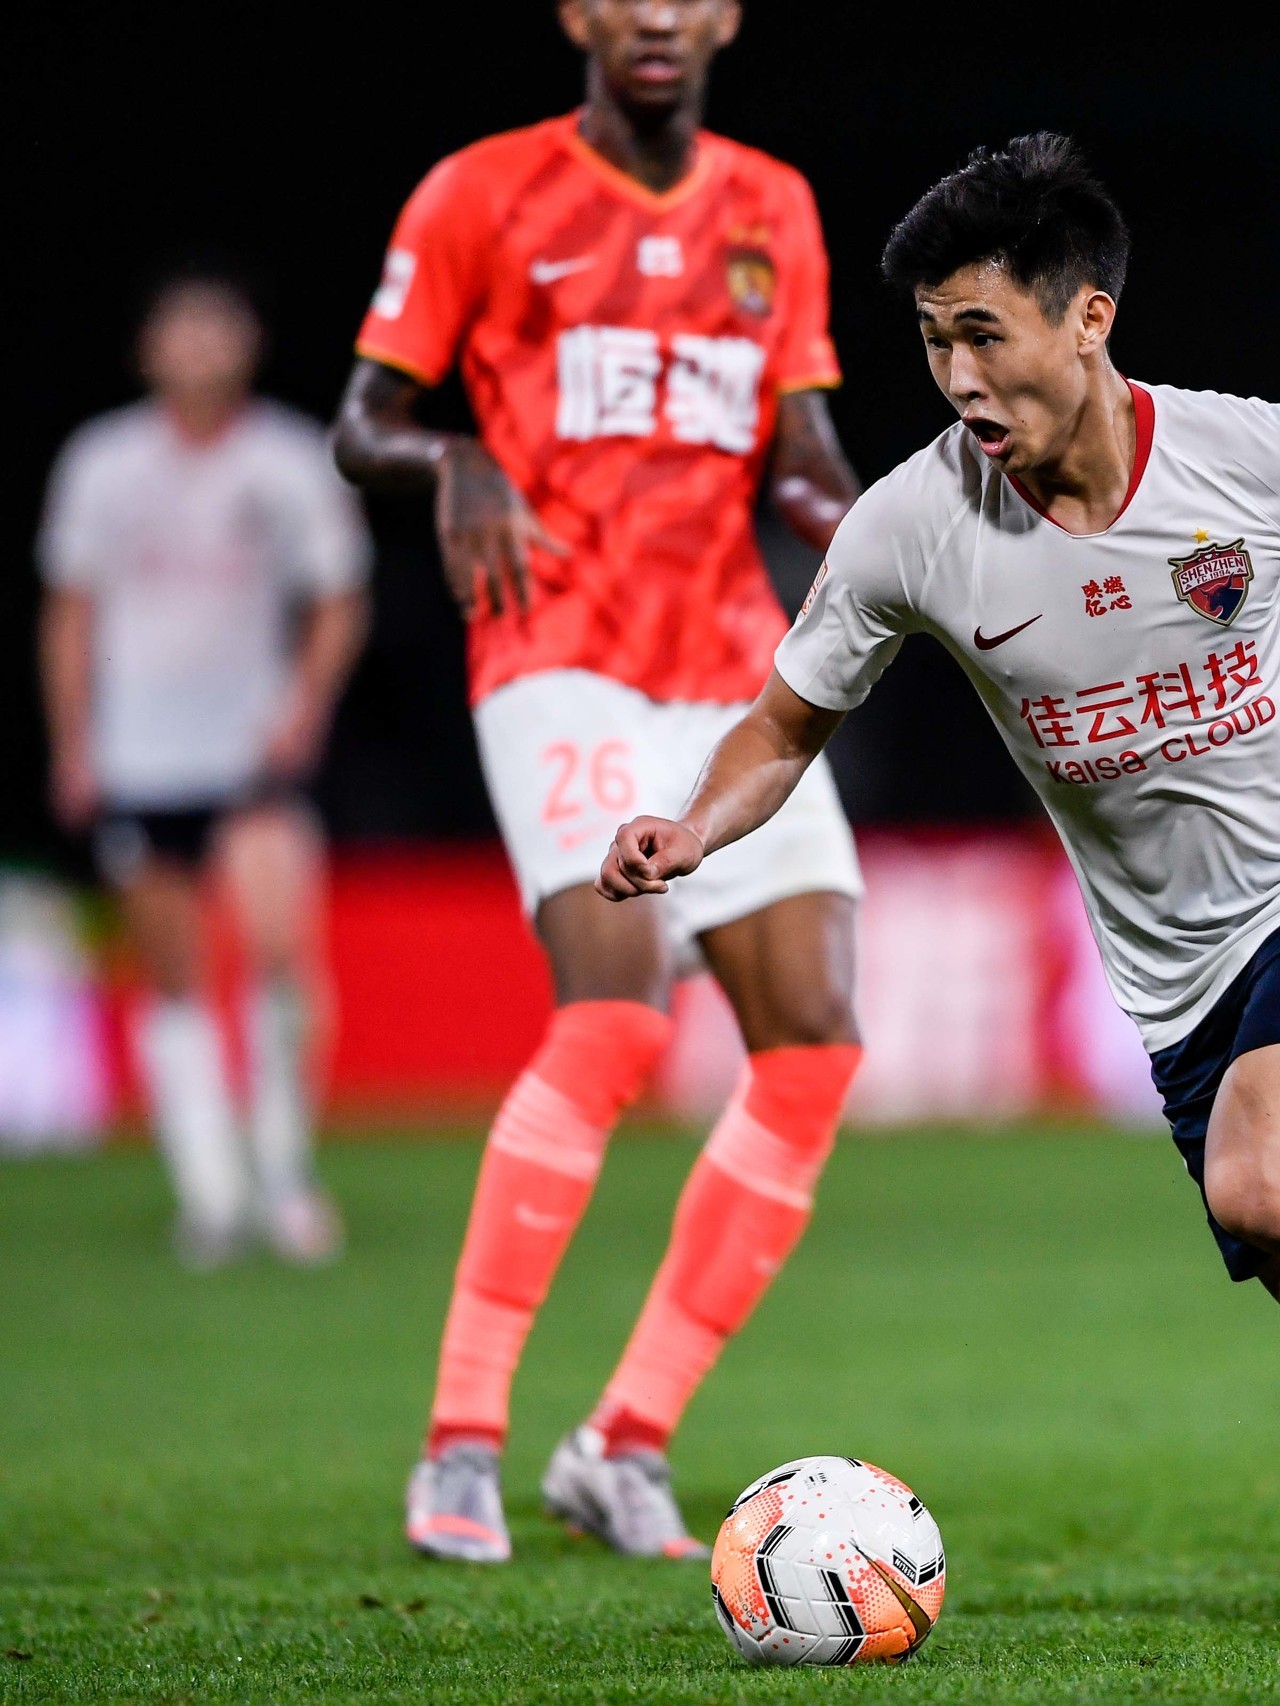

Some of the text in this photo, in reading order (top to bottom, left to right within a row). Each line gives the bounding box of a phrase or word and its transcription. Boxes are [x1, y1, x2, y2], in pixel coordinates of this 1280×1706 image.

[1180, 556, 1244, 585] SHENZHEN
[1020, 640, 1263, 750] 佳云科技
[1160, 695, 1277, 763] CLOUD
[540, 740, 637, 823] 26
